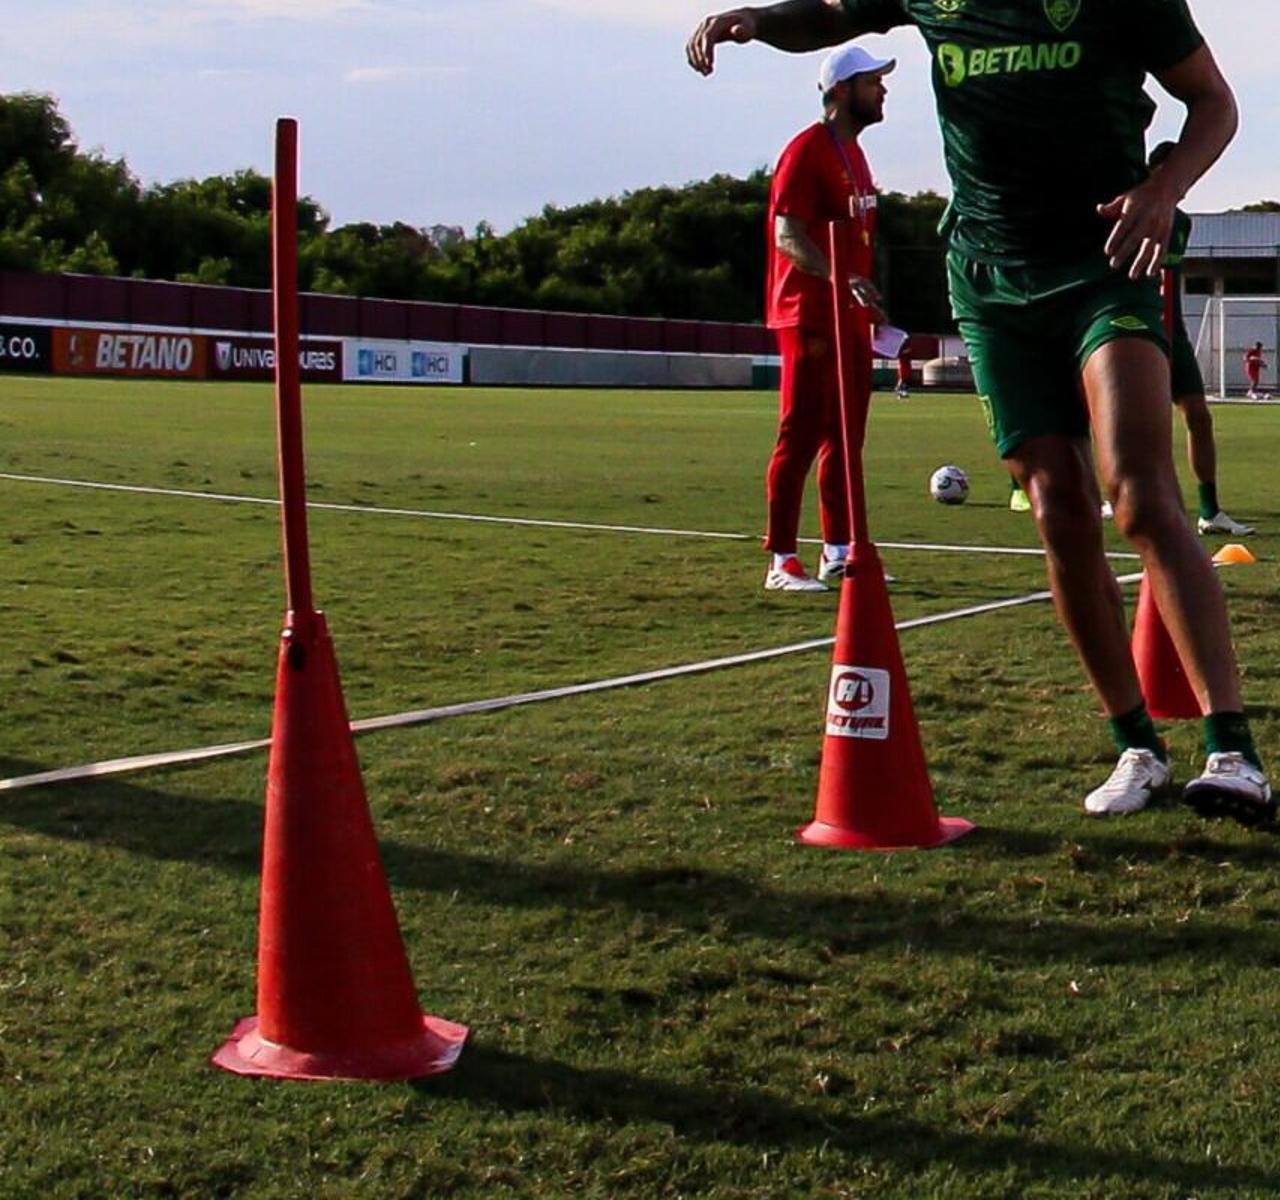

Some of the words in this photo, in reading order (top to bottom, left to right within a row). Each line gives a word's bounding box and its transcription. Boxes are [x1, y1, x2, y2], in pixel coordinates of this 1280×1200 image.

[968, 42, 1081, 76] BETANO
[96, 334, 194, 371] BETANO
[375, 355, 397, 372] HCI
[427, 356, 449, 373] HCI
